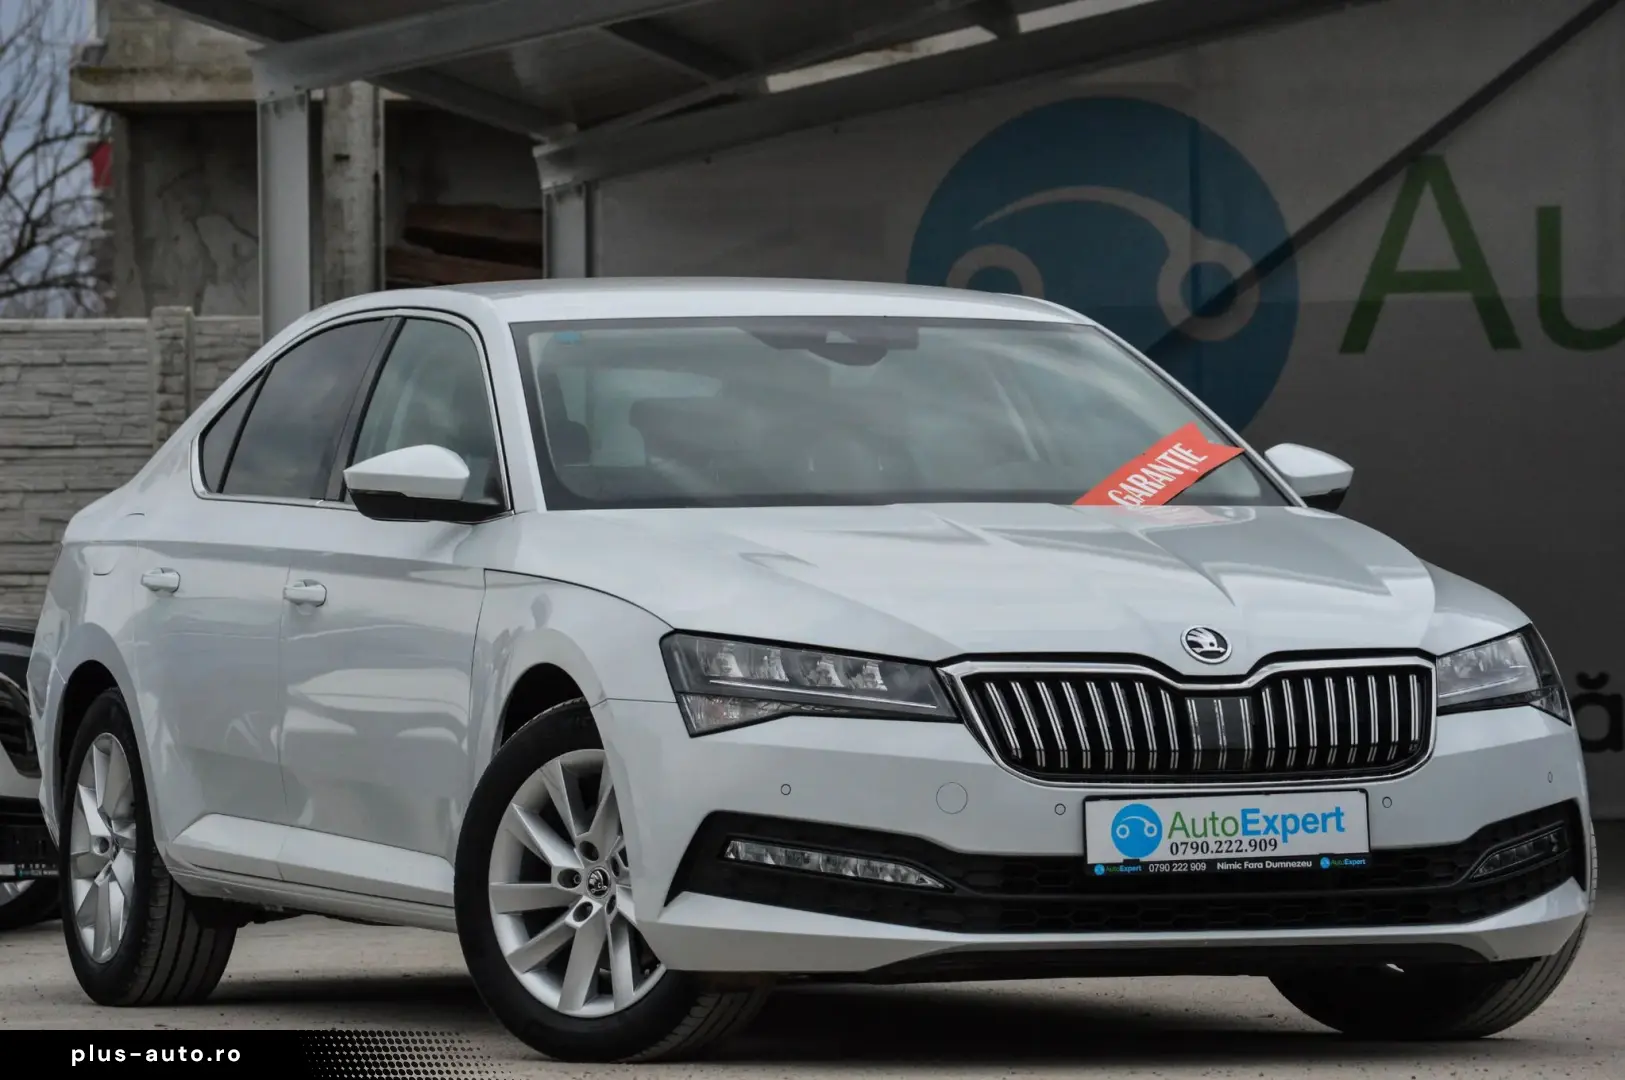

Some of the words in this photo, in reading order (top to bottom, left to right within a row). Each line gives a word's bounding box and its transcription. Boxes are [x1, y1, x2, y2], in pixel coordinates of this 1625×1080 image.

[1167, 806, 1345, 843] AutoExpert
[1169, 838, 1278, 856] 0790.222.909
[1106, 864, 1142, 873] AutoExpert
[1148, 863, 1170, 873] 0790
[1172, 862, 1189, 872] 222
[1190, 862, 1207, 872] 909
[1216, 861, 1242, 870] Nimic
[1244, 860, 1264, 869] Fara
[1265, 859, 1313, 869] Dumnezeu
[1331, 858, 1367, 867] AutoExpert
